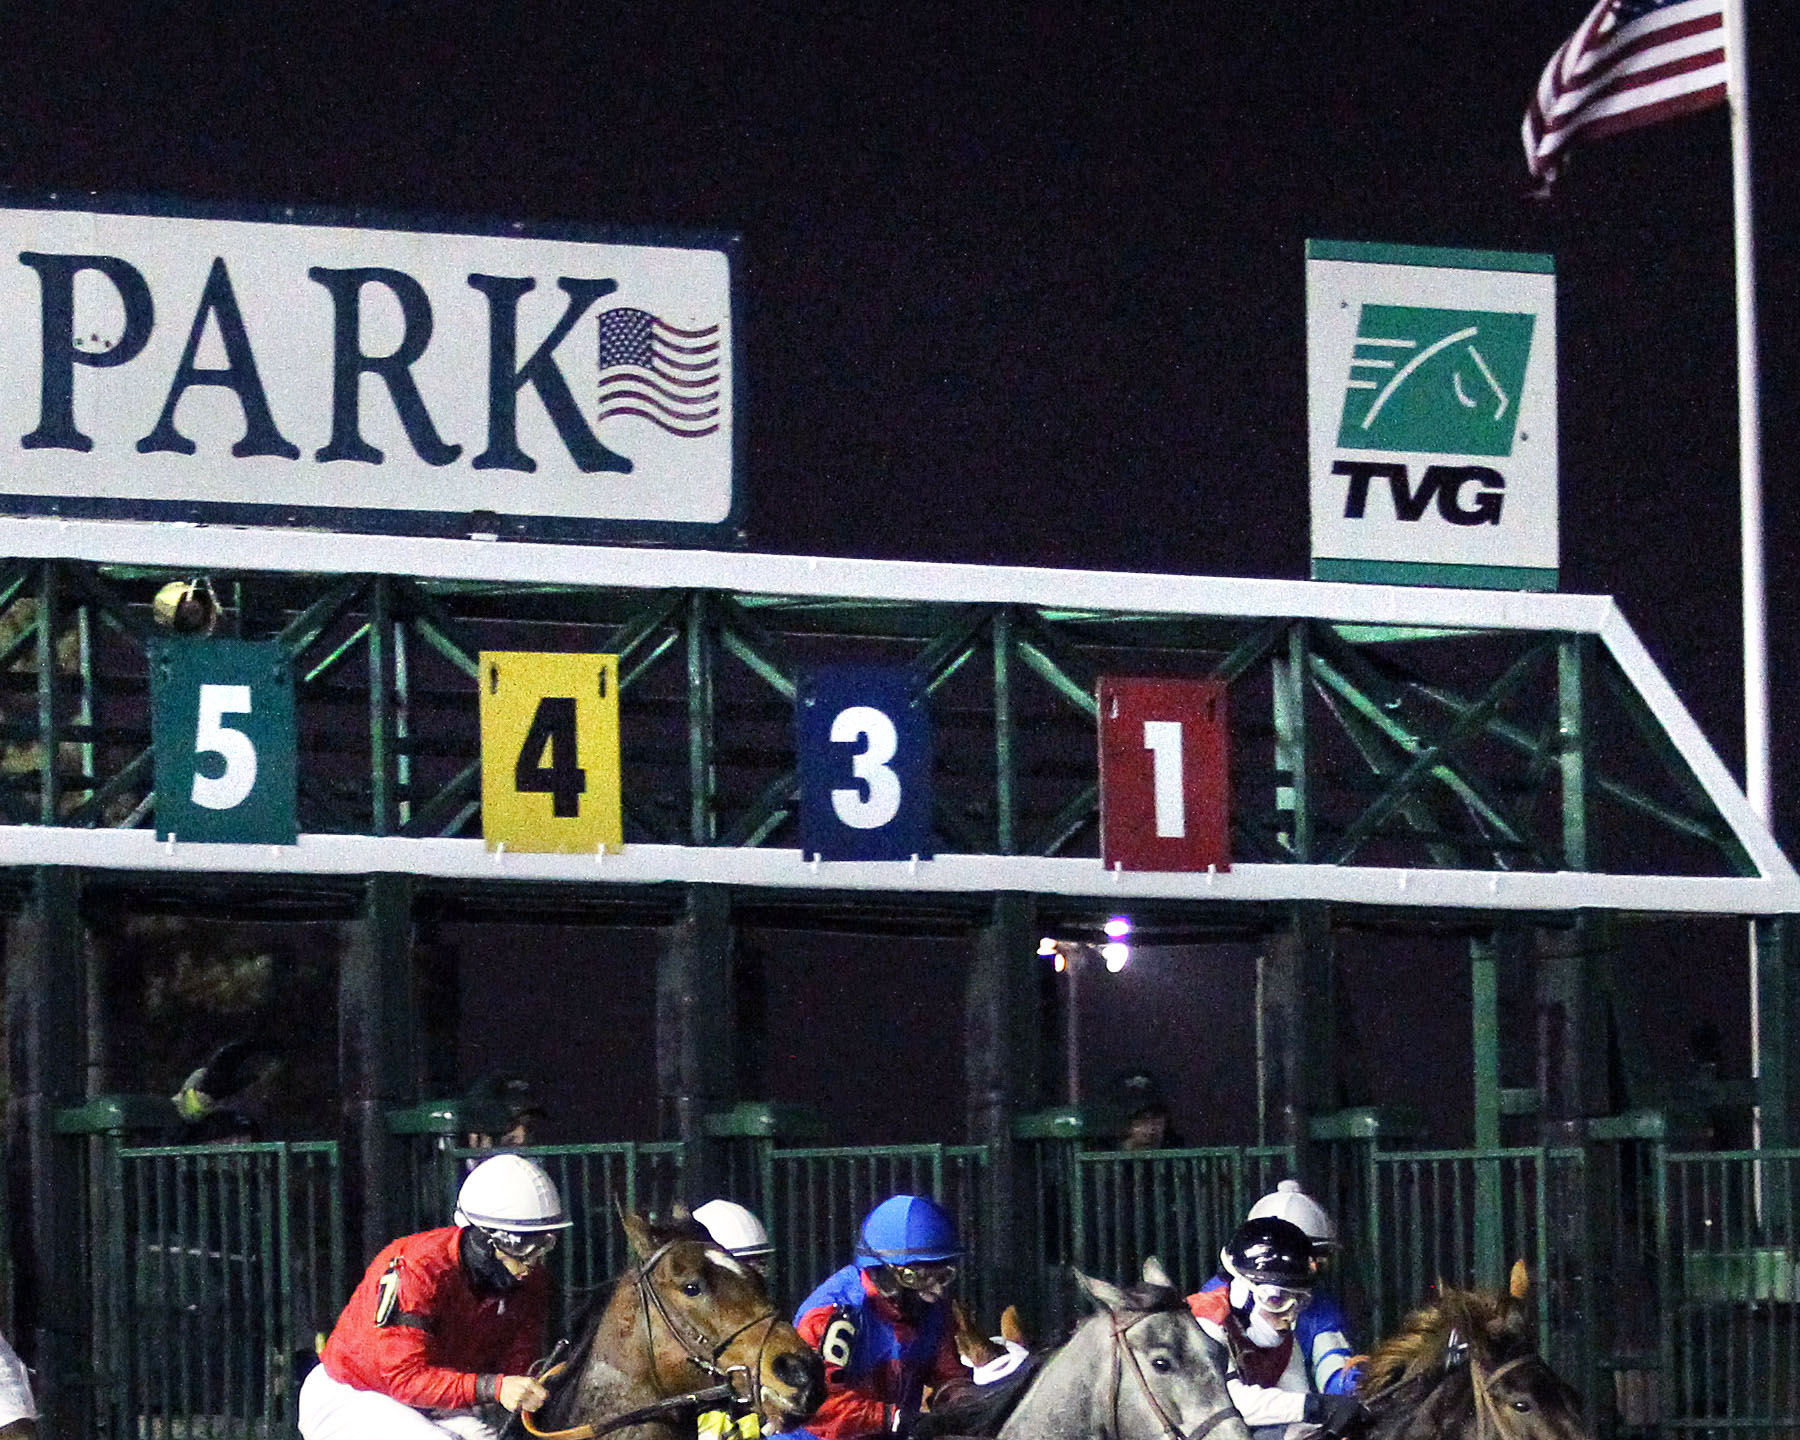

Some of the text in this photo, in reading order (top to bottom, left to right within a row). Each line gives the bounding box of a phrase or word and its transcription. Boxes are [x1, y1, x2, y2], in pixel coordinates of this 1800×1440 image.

[19, 252, 634, 473] PARK
[1331, 460, 1505, 526] TVG
[192, 685, 257, 810] 5
[515, 697, 586, 818] 4
[830, 706, 902, 829] 3
[1144, 721, 1185, 838] 1
[823, 1320, 856, 1367] 6
